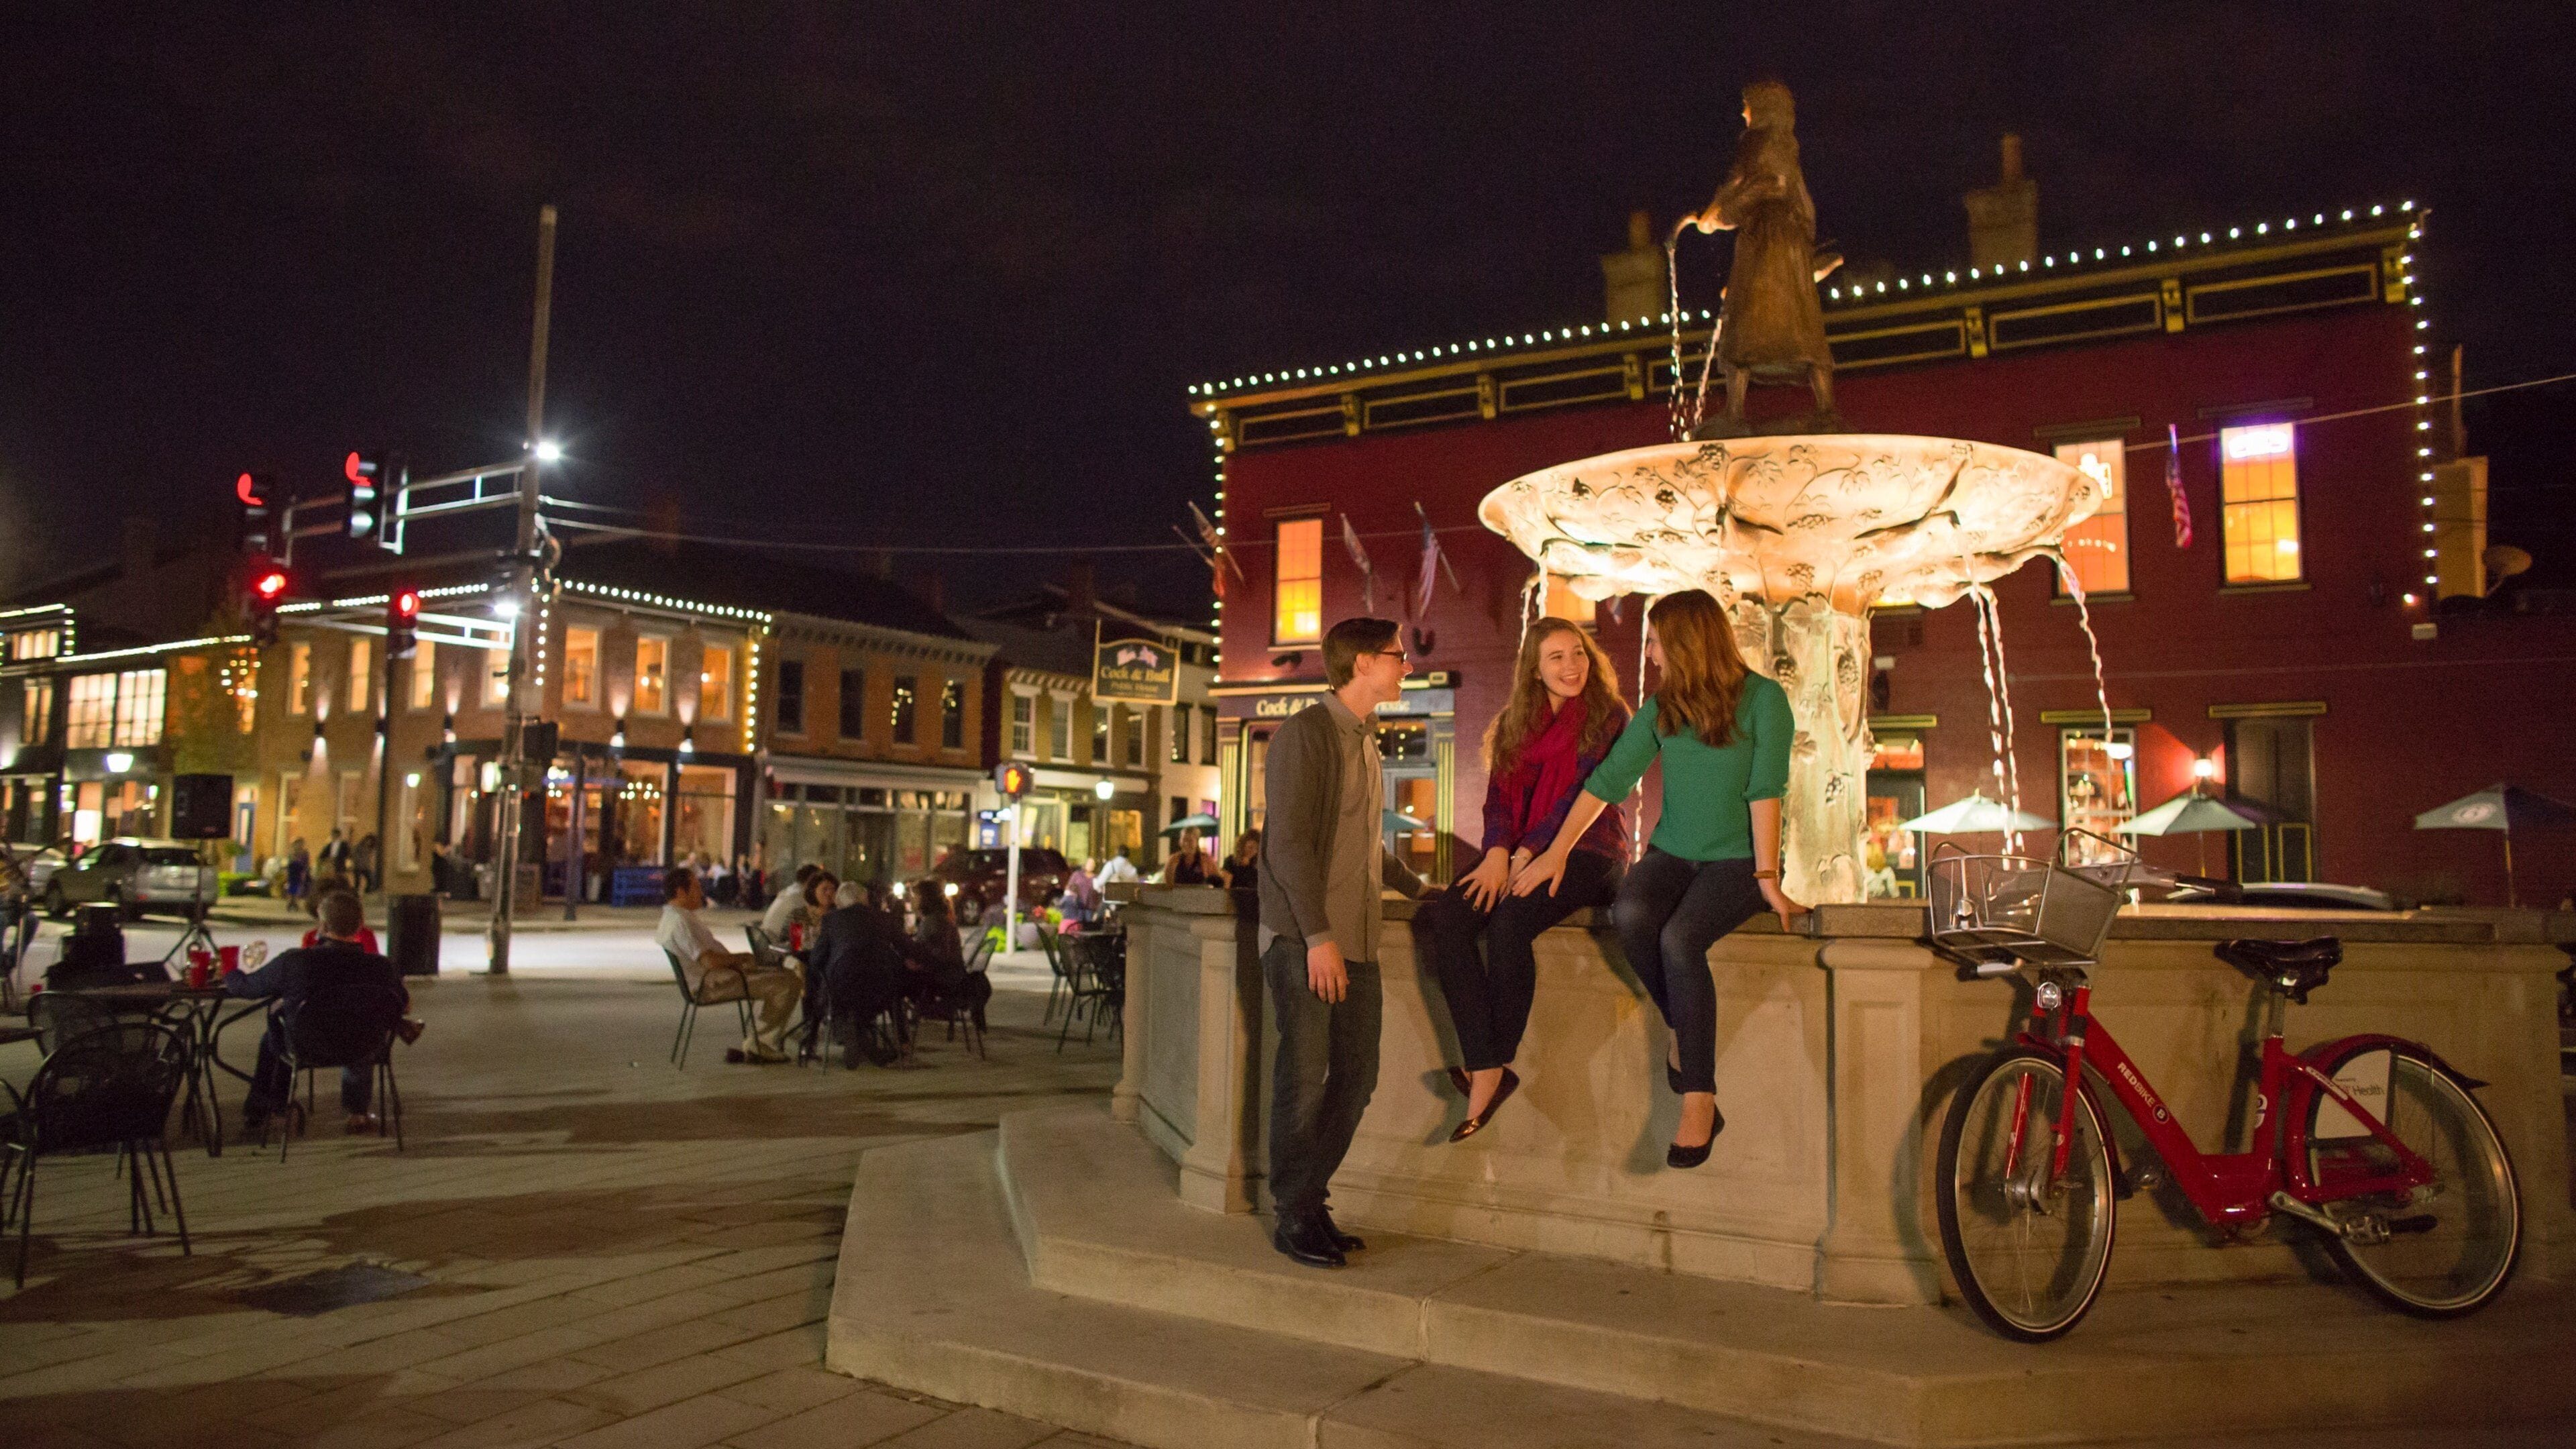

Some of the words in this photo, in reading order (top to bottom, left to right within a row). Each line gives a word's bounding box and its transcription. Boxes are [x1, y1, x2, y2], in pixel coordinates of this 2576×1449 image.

[1101, 665, 1128, 679] Cock
[1130, 668, 1142, 680] &
[1256, 697, 1287, 717] Cock
[2117, 1062, 2155, 1107] REDBIKE
[2353, 1085, 2384, 1095] Health
